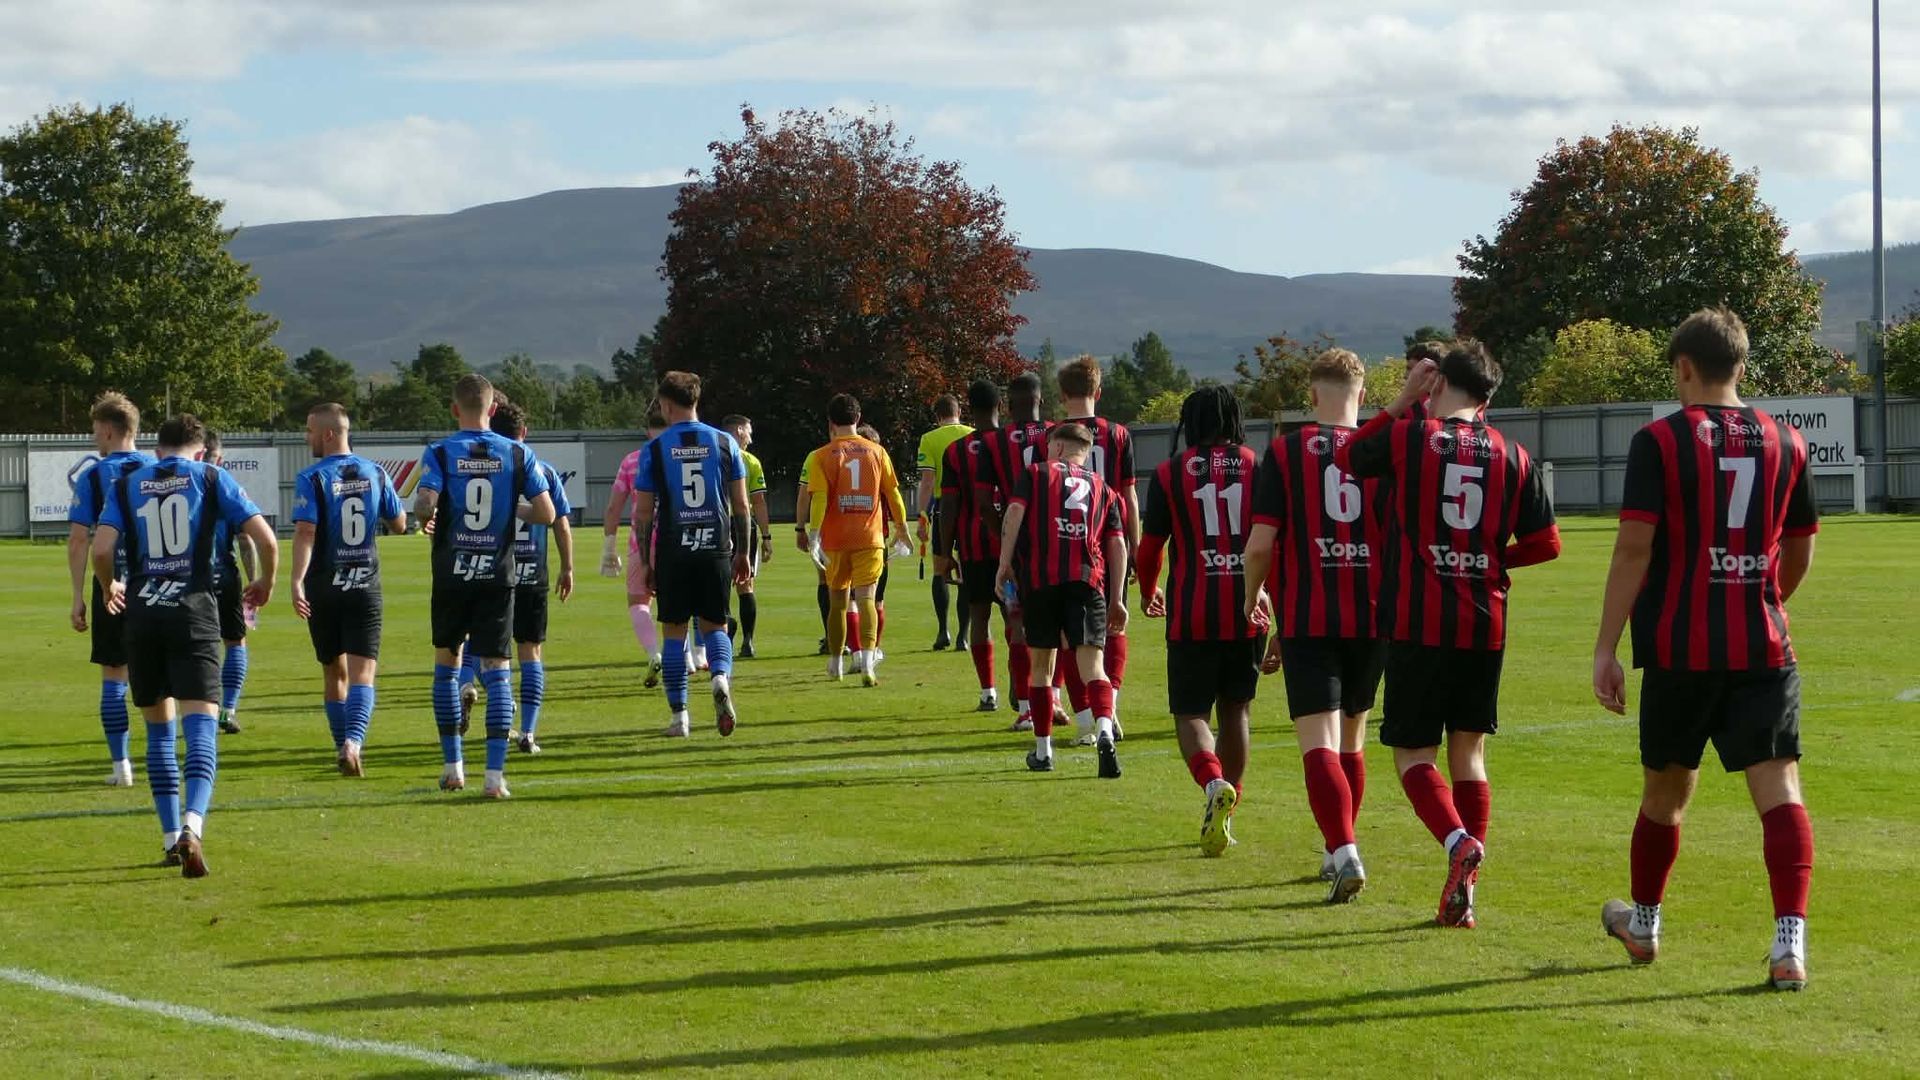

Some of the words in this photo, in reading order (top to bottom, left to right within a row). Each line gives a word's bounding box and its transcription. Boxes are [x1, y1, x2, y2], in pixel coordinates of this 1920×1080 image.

[1769, 408, 1827, 429] ntown
[1729, 424, 1765, 436] BSW
[672, 447, 710, 456] Premier
[1461, 435, 1493, 448] BSW
[1731, 437, 1775, 448] Timber
[1809, 442, 1846, 462] Park
[1213, 458, 1243, 467] BSW
[1462, 447, 1501, 459] Timber
[457, 459, 502, 469] Premier
[844, 459, 860, 490] 1
[140, 477, 190, 490] Premier
[681, 462, 706, 508] 5
[1324, 463, 1361, 522] 6
[1719, 457, 1756, 528] 7
[464, 478, 493, 531] 9
[1065, 477, 1091, 512] 2
[1442, 463, 1484, 529] 5
[34, 506, 52, 515] THE
[1192, 483, 1243, 535] 11
[137, 494, 190, 558] 10
[342, 497, 366, 546] 6
[1055, 518, 1087, 536] Yop
[456, 533, 495, 543] Westgate
[1315, 538, 1370, 560] Yopa
[1428, 545, 1489, 571] Yopa
[147, 559, 191, 571] Westgate
[1709, 547, 1769, 576] Yopa
